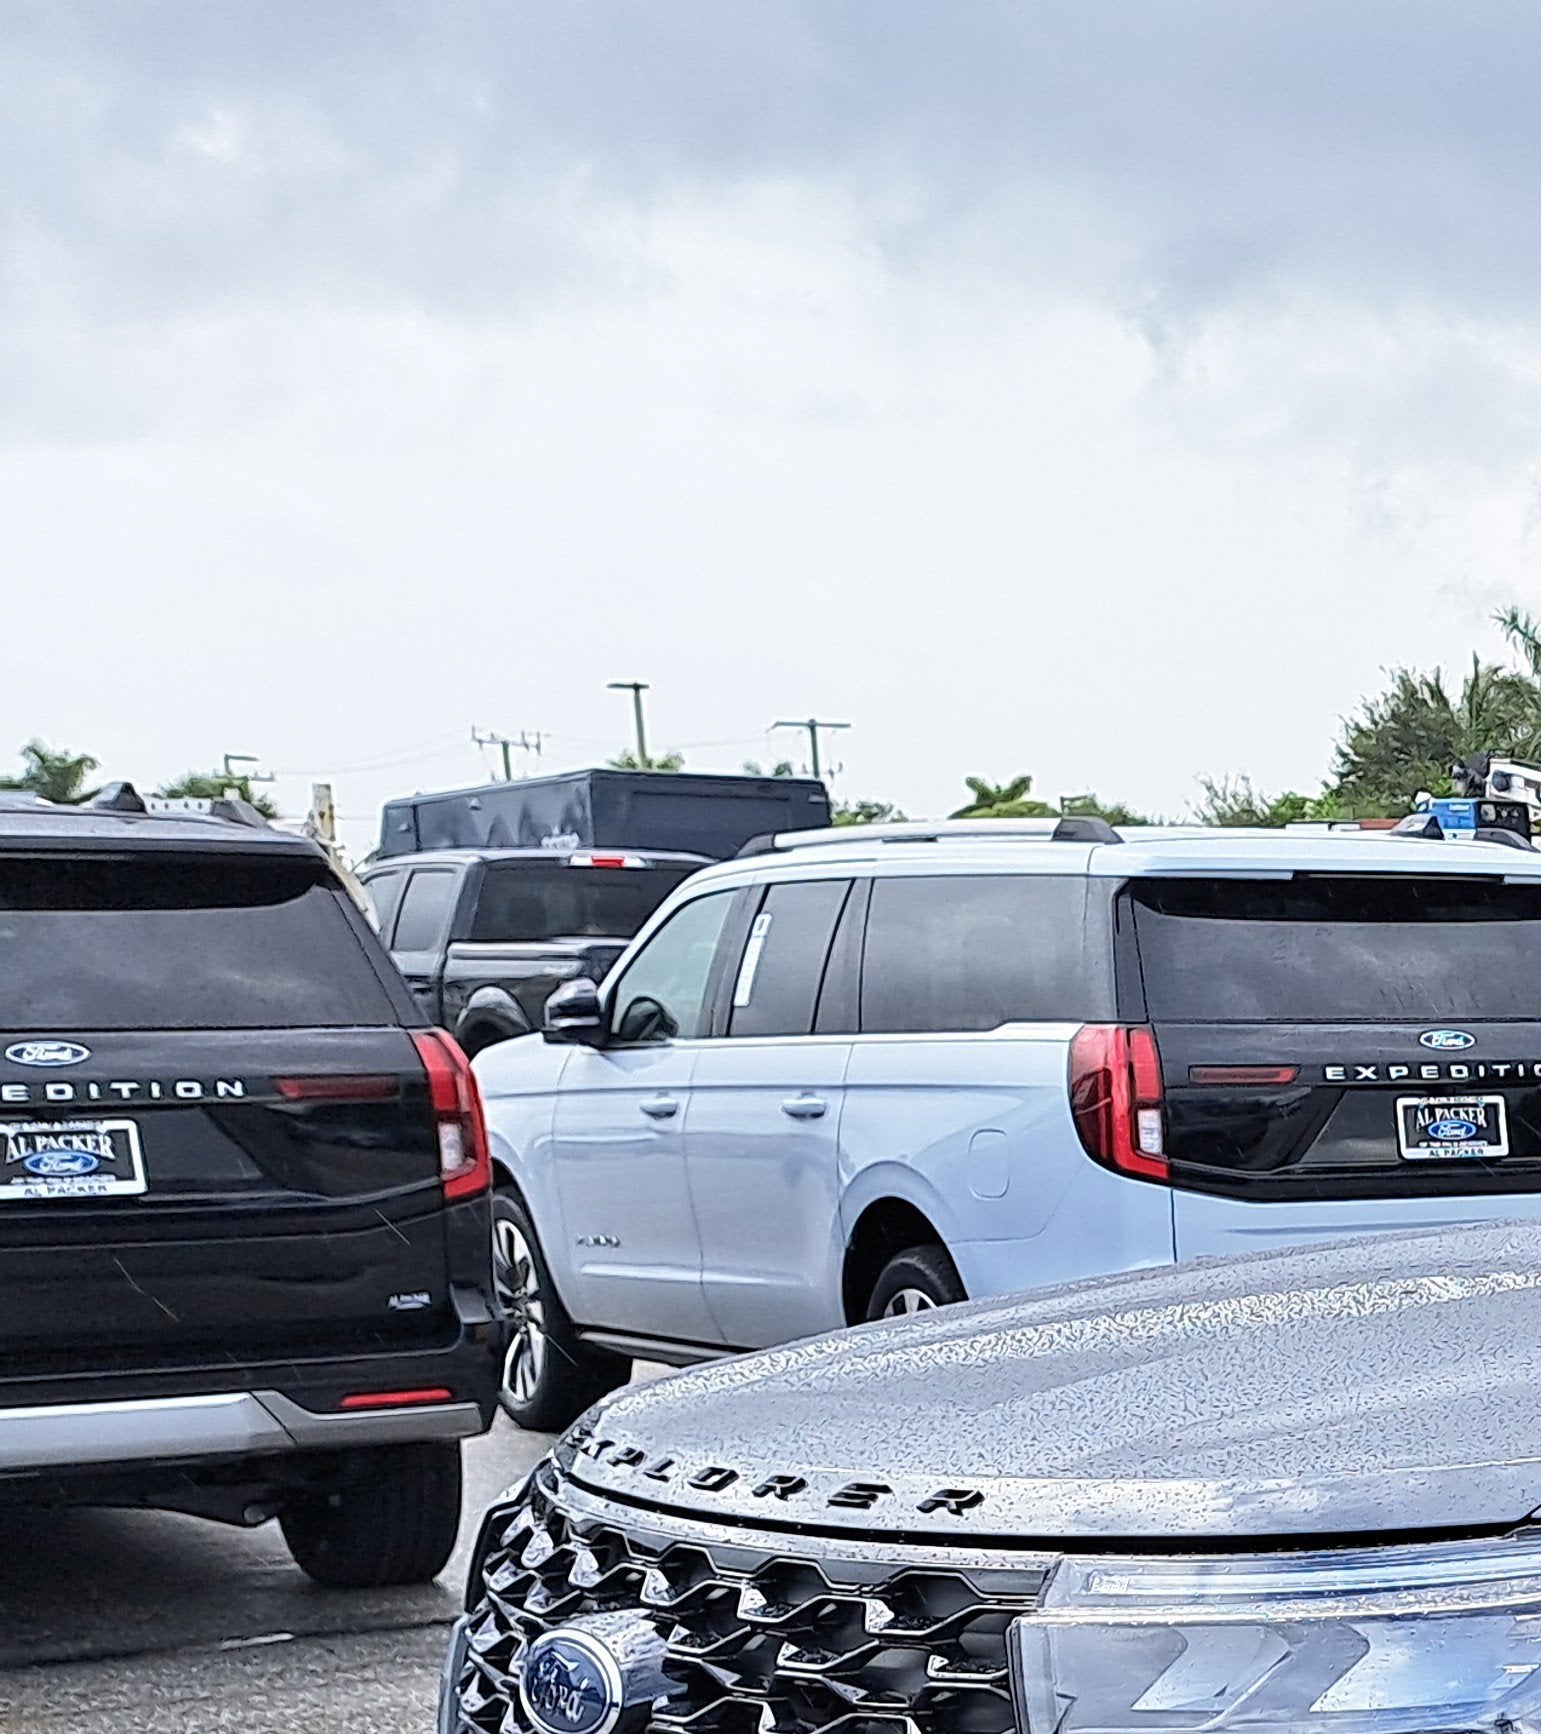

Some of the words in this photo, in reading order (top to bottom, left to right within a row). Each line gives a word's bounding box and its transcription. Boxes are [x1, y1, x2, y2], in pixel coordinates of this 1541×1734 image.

[1415, 1106, 1433, 1132] AL
[1434, 1107, 1487, 1128] PACKER
[6, 1135, 34, 1164] AL
[35, 1134, 116, 1160] PACKER
[531, 1650, 589, 1723] Ford
